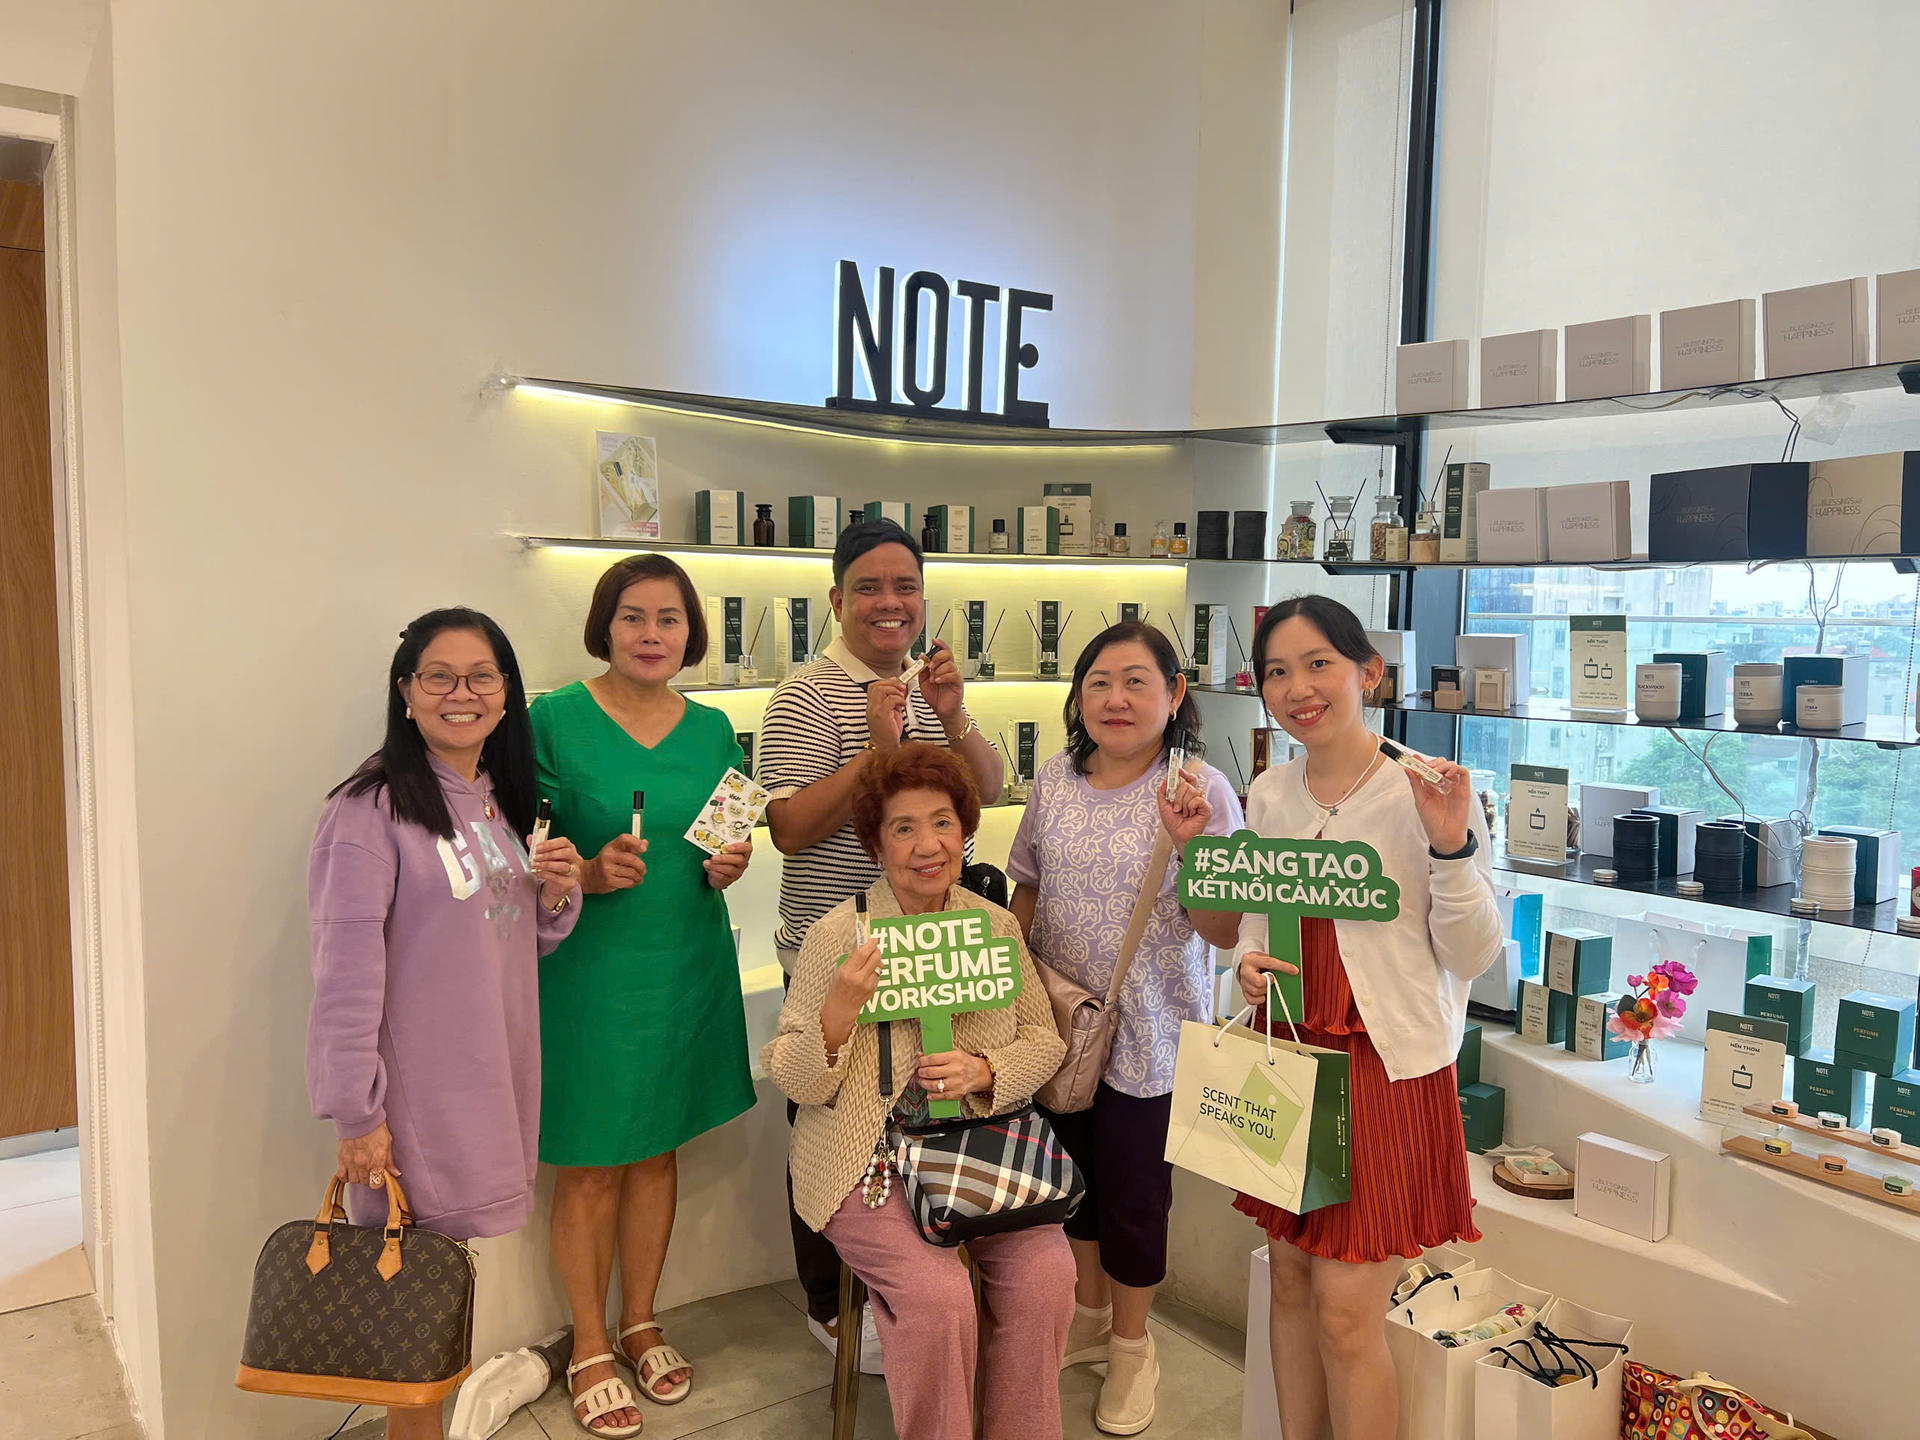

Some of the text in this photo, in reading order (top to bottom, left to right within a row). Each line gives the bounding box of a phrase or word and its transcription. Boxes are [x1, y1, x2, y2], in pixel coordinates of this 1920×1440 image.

[832, 259, 1054, 417] NOTE
[1783, 327, 1835, 342] HAPPINESS
[1677, 344, 1724, 357] HAPPINESS
[1815, 505, 1862, 517] HAPPINESS
[436, 821, 531, 901] GA
[1194, 841, 1370, 886] #SÁNG TẠO
[1187, 872, 1388, 910] KẾT NỐI CẢM XÚC
[870, 917, 984, 955] #NOTE
[878, 946, 1012, 988] ERFUME
[1767, 992, 1780, 1000] NOTE
[1760, 1011, 1785, 1020] PERFUME
[1861, 1009, 1875, 1018] NOTE
[1739, 1022, 1754, 1031] NOTE
[1853, 1026, 1879, 1037] PERFUME
[1815, 1067, 1829, 1076] NOTE
[1809, 1085, 1835, 1096] PERFUME
[1897, 1087, 1912, 1096] NOTE
[1202, 1086, 1278, 1122] SCENT THAT
[1889, 1105, 1916, 1116] PERFUME
[1199, 1102, 1276, 1141] SPEAKS YOU.
[1592, 1182, 1639, 1203] HAPPINESS
